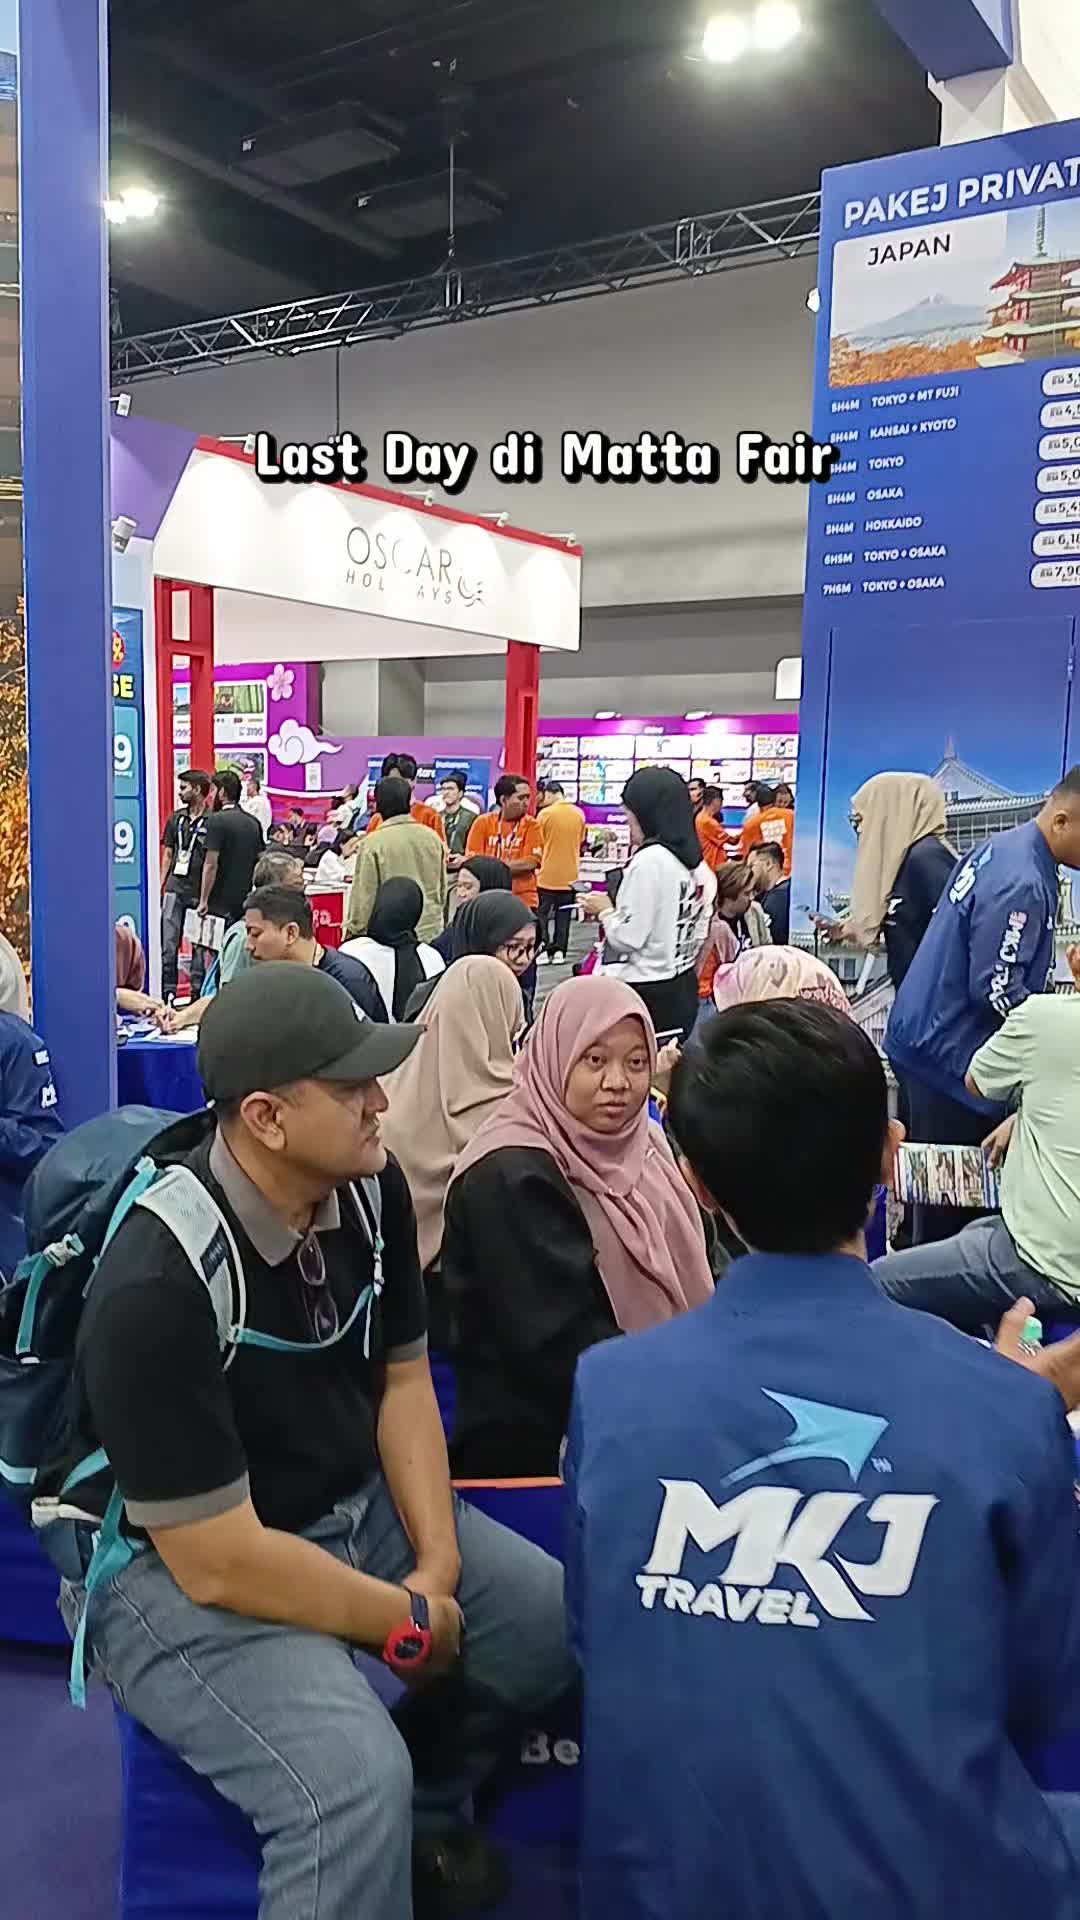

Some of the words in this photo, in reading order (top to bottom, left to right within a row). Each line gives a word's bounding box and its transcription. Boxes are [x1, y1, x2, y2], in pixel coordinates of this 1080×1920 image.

[844, 183, 948, 229] PAKEJ
[867, 234, 951, 266] JAPAN
[871, 393, 907, 407] TOKYO
[917, 389, 934, 402] MT
[935, 386, 959, 399] FUJI
[870, 424, 910, 439] KANSAI
[919, 418, 957, 433] KYOTO
[868, 456, 905, 470] TOKYO
[867, 487, 904, 501] OSAKA
[865, 516, 922, 532] HOKKAIDO
[863, 549, 899, 562] TOKYO
[908, 545, 947, 559] OSAKA
[862, 580, 898, 593] TOKYO
[907, 577, 945, 590] OSAKA
[640, 1477, 941, 1622] MKJ
[635, 1574, 820, 1628] TRAVEL
